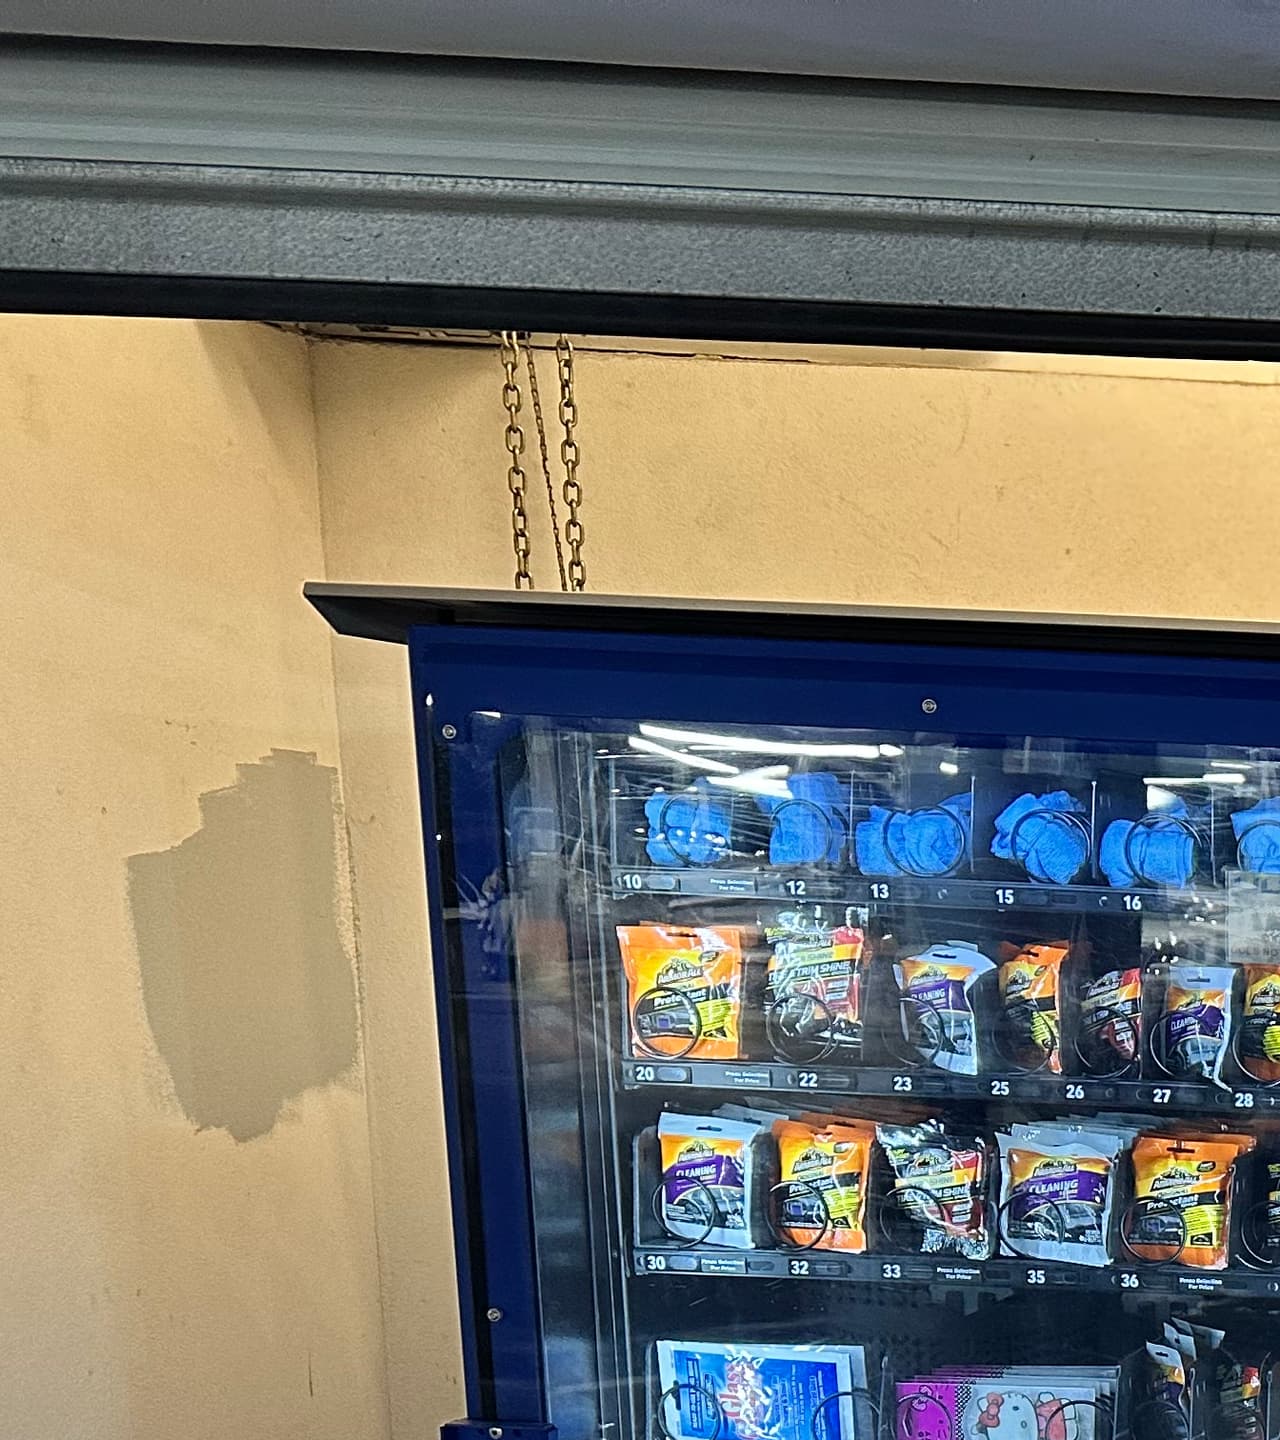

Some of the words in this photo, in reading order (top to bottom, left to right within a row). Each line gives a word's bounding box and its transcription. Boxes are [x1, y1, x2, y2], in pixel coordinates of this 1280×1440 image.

[622, 873, 644, 890] 10
[786, 880, 807, 895] 12
[870, 883, 890, 899] 13
[995, 889, 1014, 905] 15
[1123, 894, 1142, 911] 16
[635, 1066, 655, 1082] 20
[798, 1072, 818, 1088] 22
[893, 1076, 913, 1092] 23
[991, 1080, 1010, 1096] 25
[1066, 1084, 1085, 1099] 26
[1153, 1088, 1171, 1104] 27
[1234, 1092, 1254, 1108] 28
[647, 1255, 666, 1270] 30
[790, 1260, 809, 1275] 32
[882, 1263, 902, 1279] 33
[1027, 1269, 1046, 1284] 35
[1120, 1273, 1139, 1288] 36
